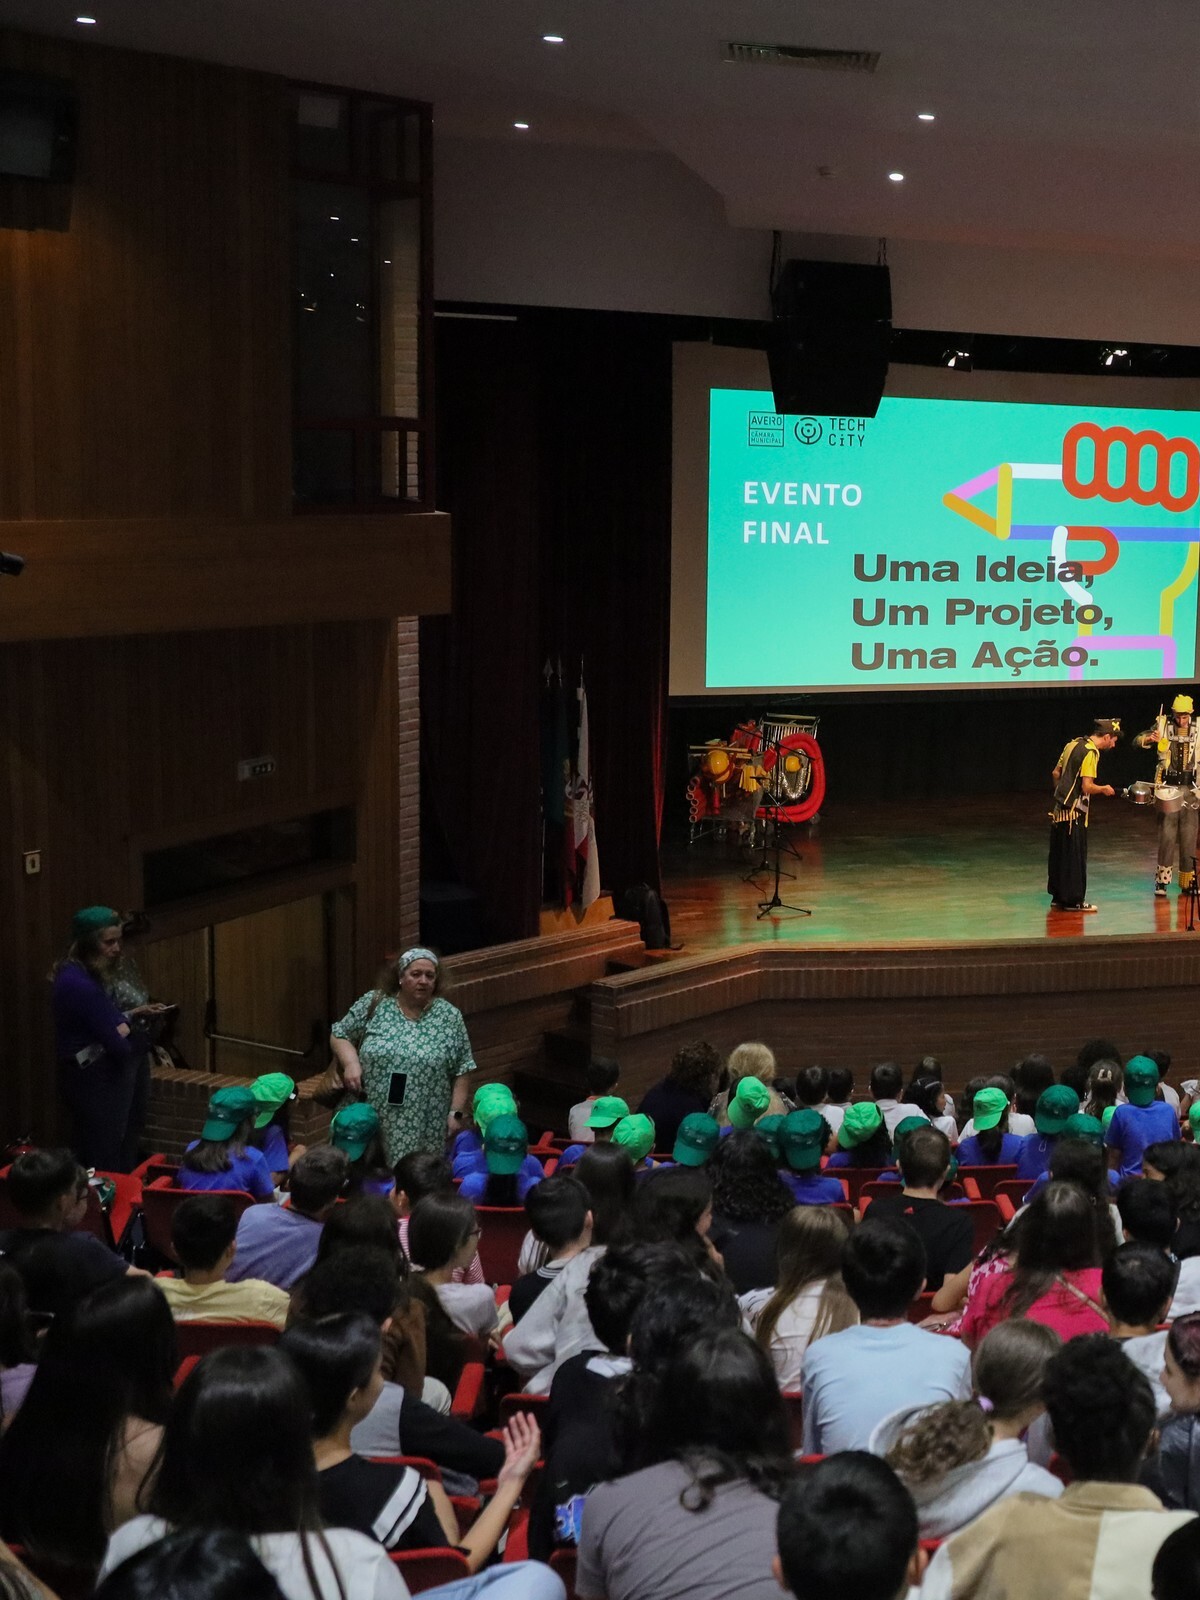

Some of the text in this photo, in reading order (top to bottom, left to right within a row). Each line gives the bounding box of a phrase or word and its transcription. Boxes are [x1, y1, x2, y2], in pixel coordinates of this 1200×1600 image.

[752, 416, 782, 426] AVEIRO
[829, 418, 866, 431] TECH
[743, 481, 862, 507] EVENTO
[743, 521, 829, 545] FINAL
[853, 554, 1094, 588] Uma Ideia,
[852, 598, 1113, 631] Um Projeto,
[851, 640, 1099, 677] Uma Ação.
